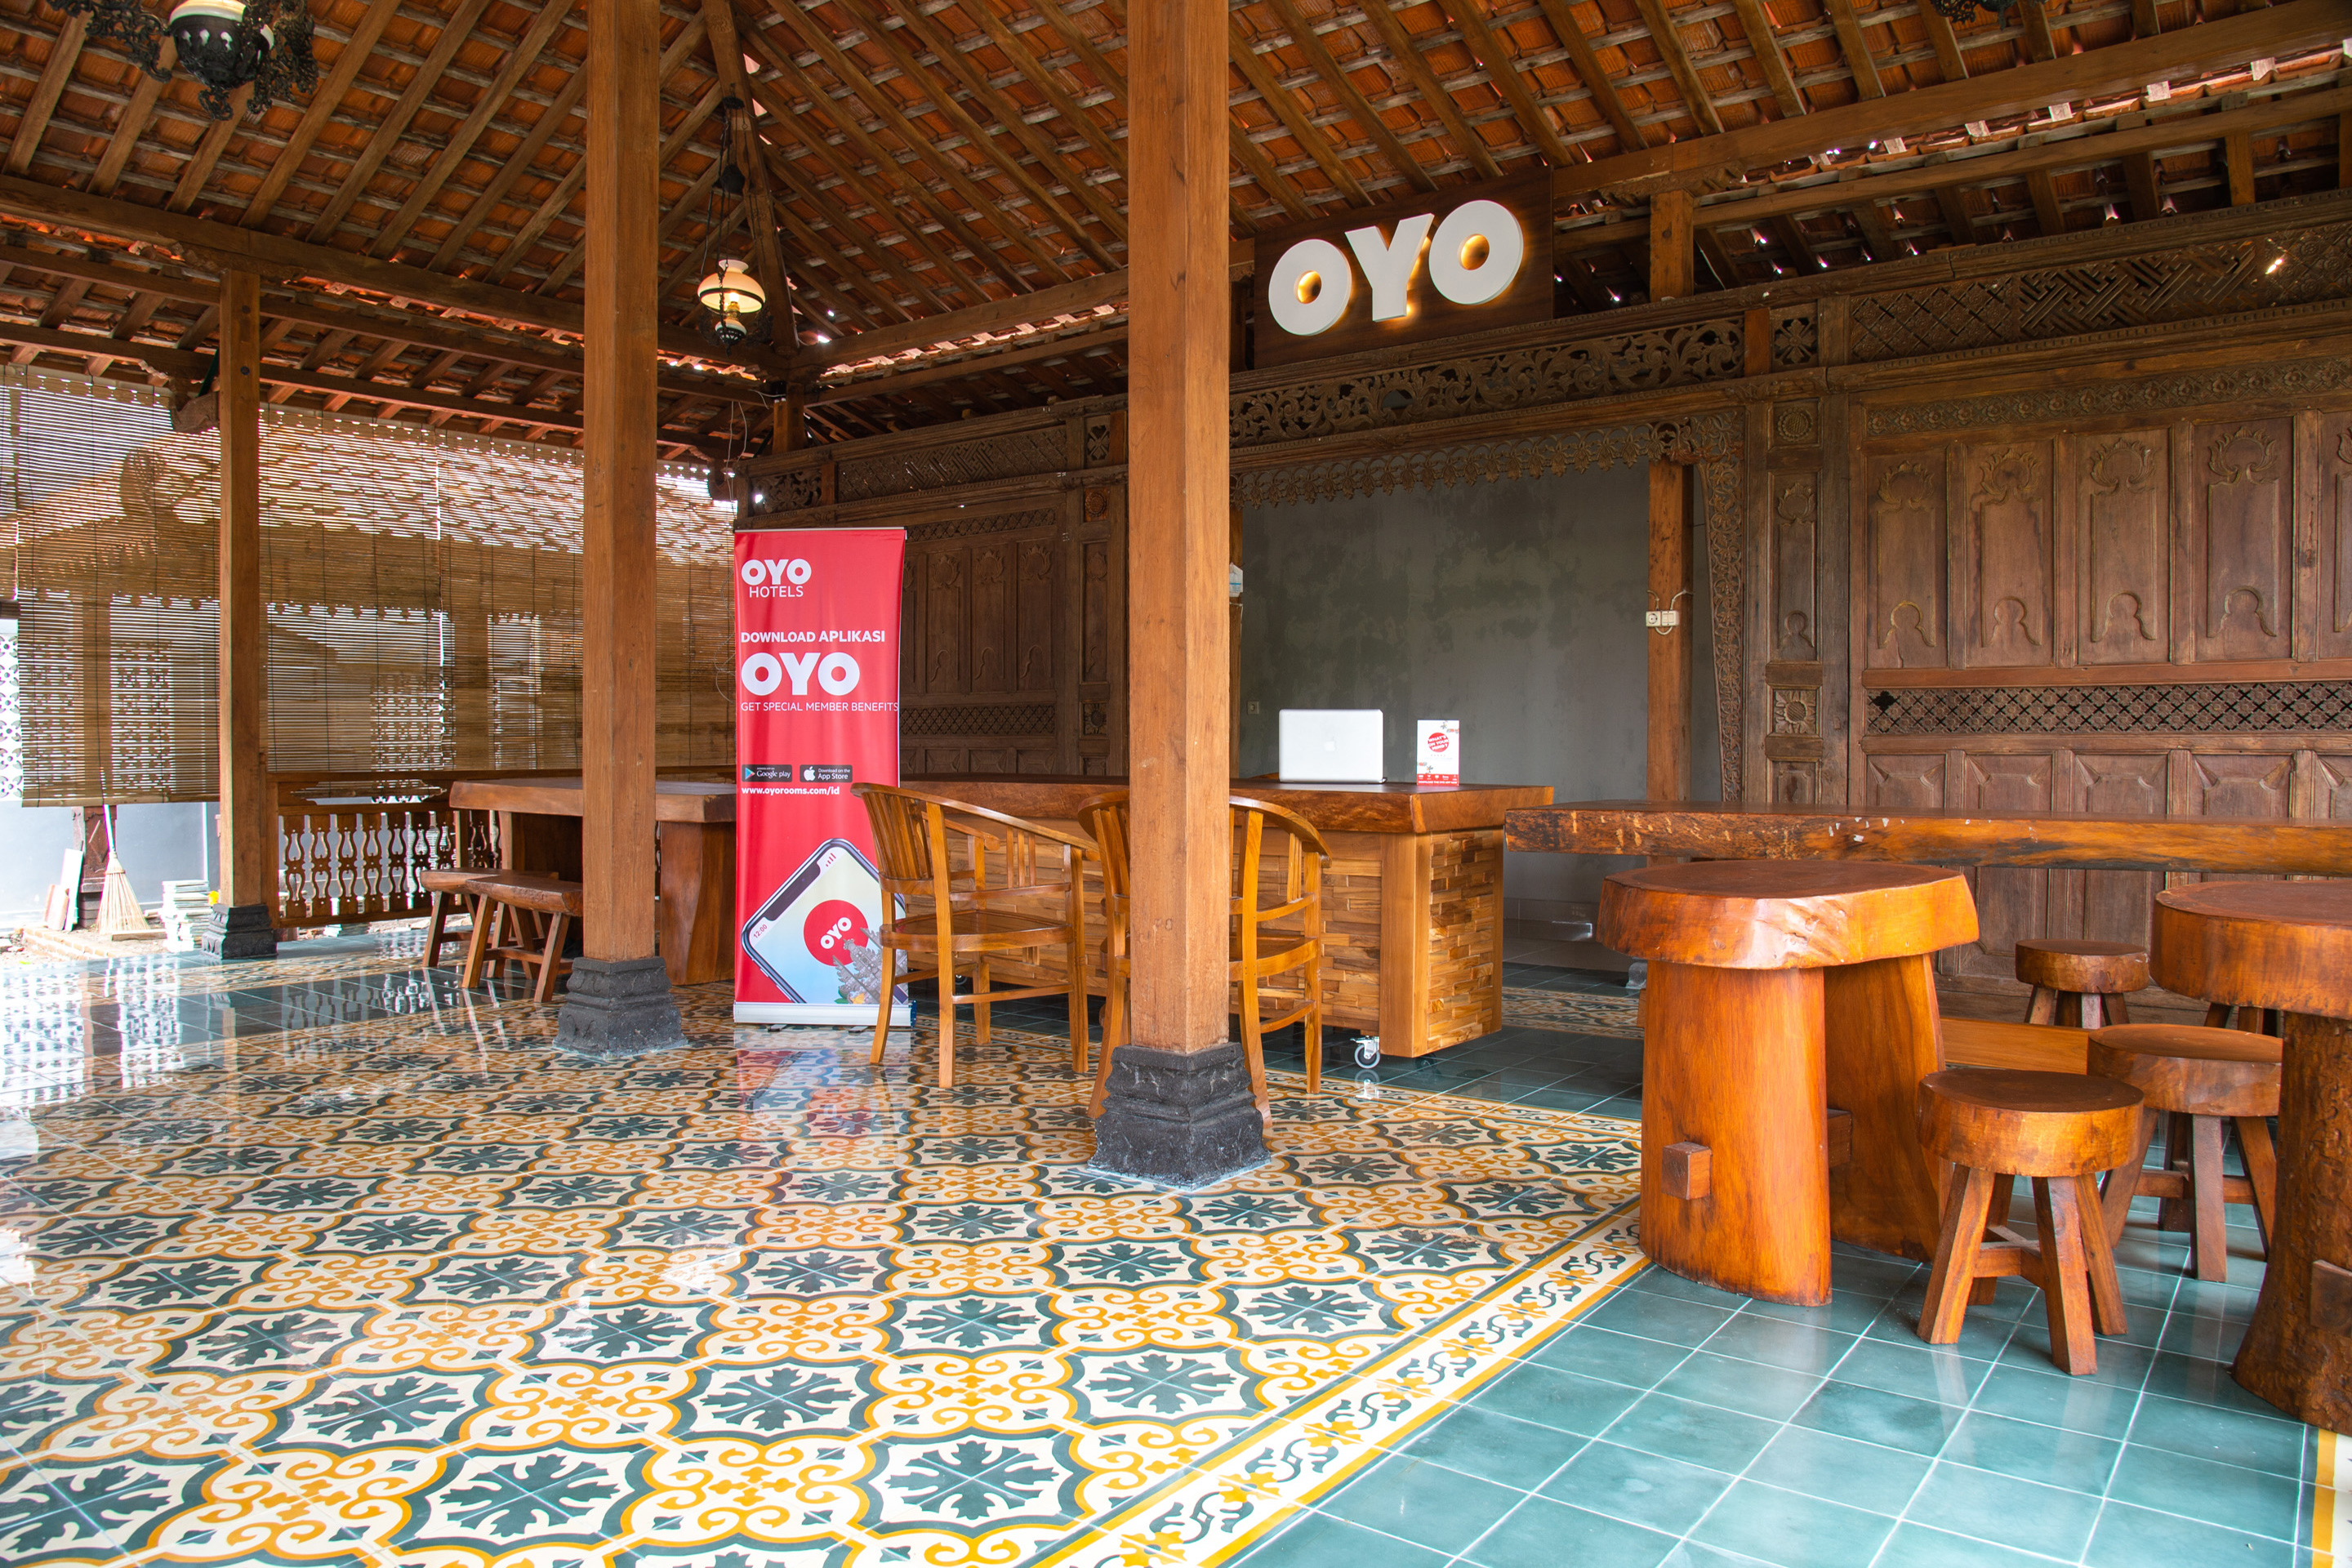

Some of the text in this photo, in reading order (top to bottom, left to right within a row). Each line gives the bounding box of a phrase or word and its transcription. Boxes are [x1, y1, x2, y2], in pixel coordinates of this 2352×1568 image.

[1268, 199, 1524, 336] OYO
[741, 558, 812, 586] OYO
[749, 585, 804, 598] HOTELS
[741, 630, 885, 643] DOWNLOAD APLIKASI
[741, 652, 860, 696] OYO
[741, 702, 898, 711] GET SPECIAL MEMBER BENEFITS
[756, 770, 791, 779] Google play
[817, 773, 831, 781] App
[741, 786, 840, 795] www.oyorooms.com/id
[753, 924, 768, 938] 12:00
[820, 917, 852, 949] OYO
